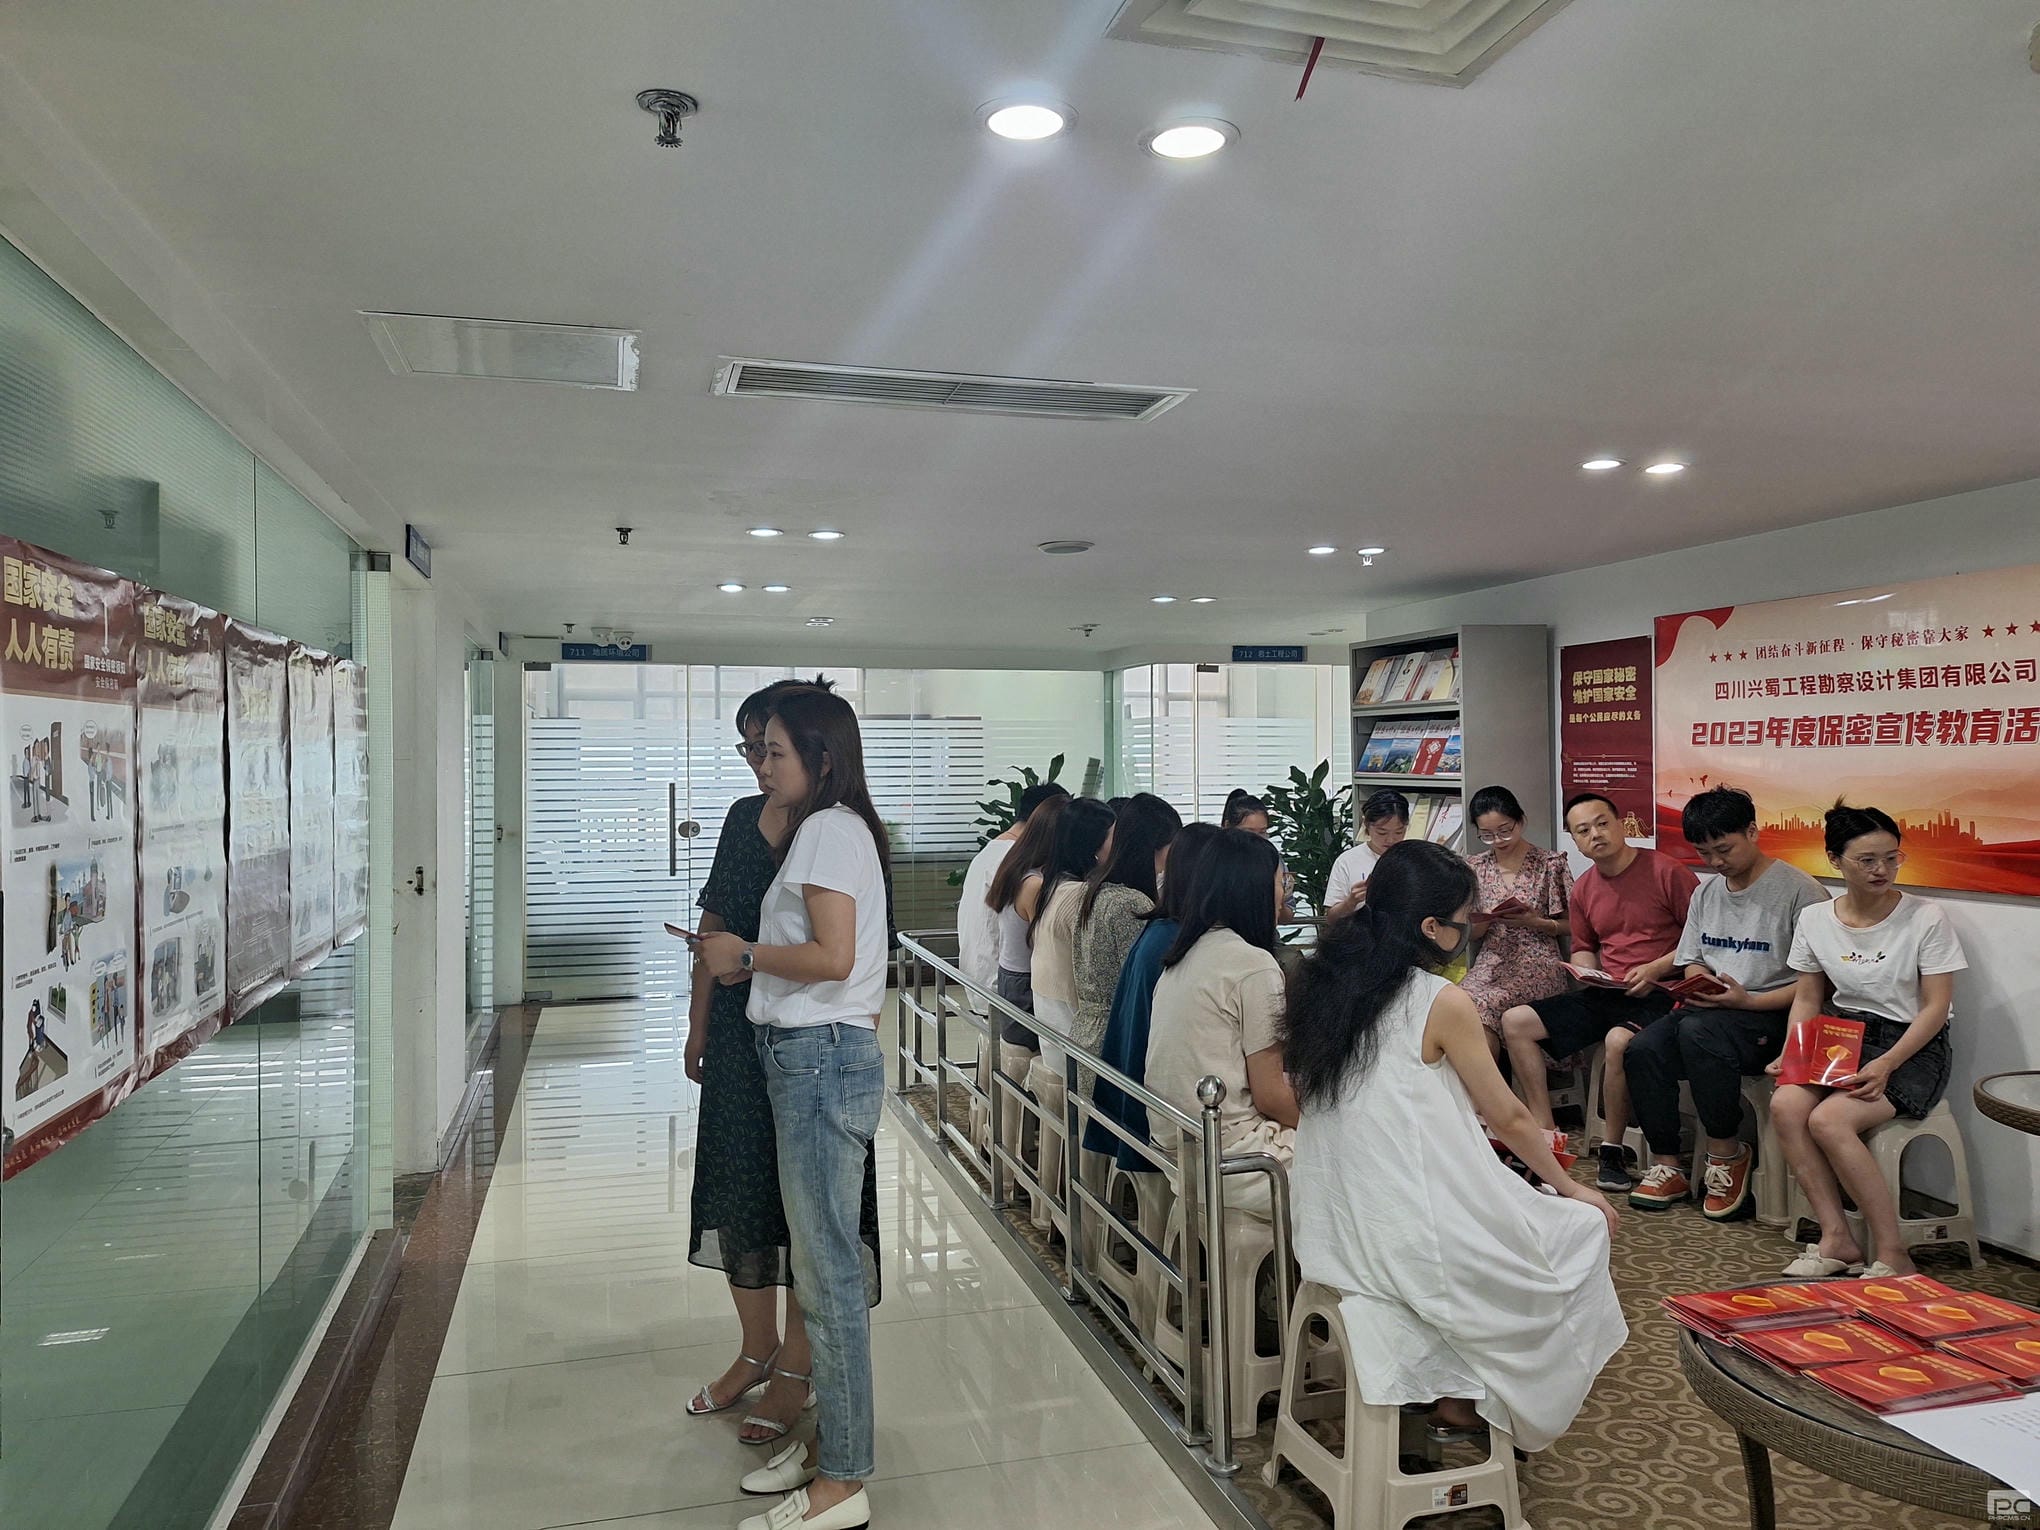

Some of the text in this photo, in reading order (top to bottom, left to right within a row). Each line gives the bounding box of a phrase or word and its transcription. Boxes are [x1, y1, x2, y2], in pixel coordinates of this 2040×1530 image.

[4, 555, 75, 618] 国家安全
[5, 618, 75, 672] 人人有责
[144, 602, 187, 648] 国家安全
[1573, 666, 1637, 686] 保守国家秘密
[1573, 685, 1637, 704] 维护国家安全
[1715, 658, 2037, 700] 四川兴蜀工程勘察设计集团有限公司
[1691, 705, 2040, 748] 2023年度保密宣传教育活
